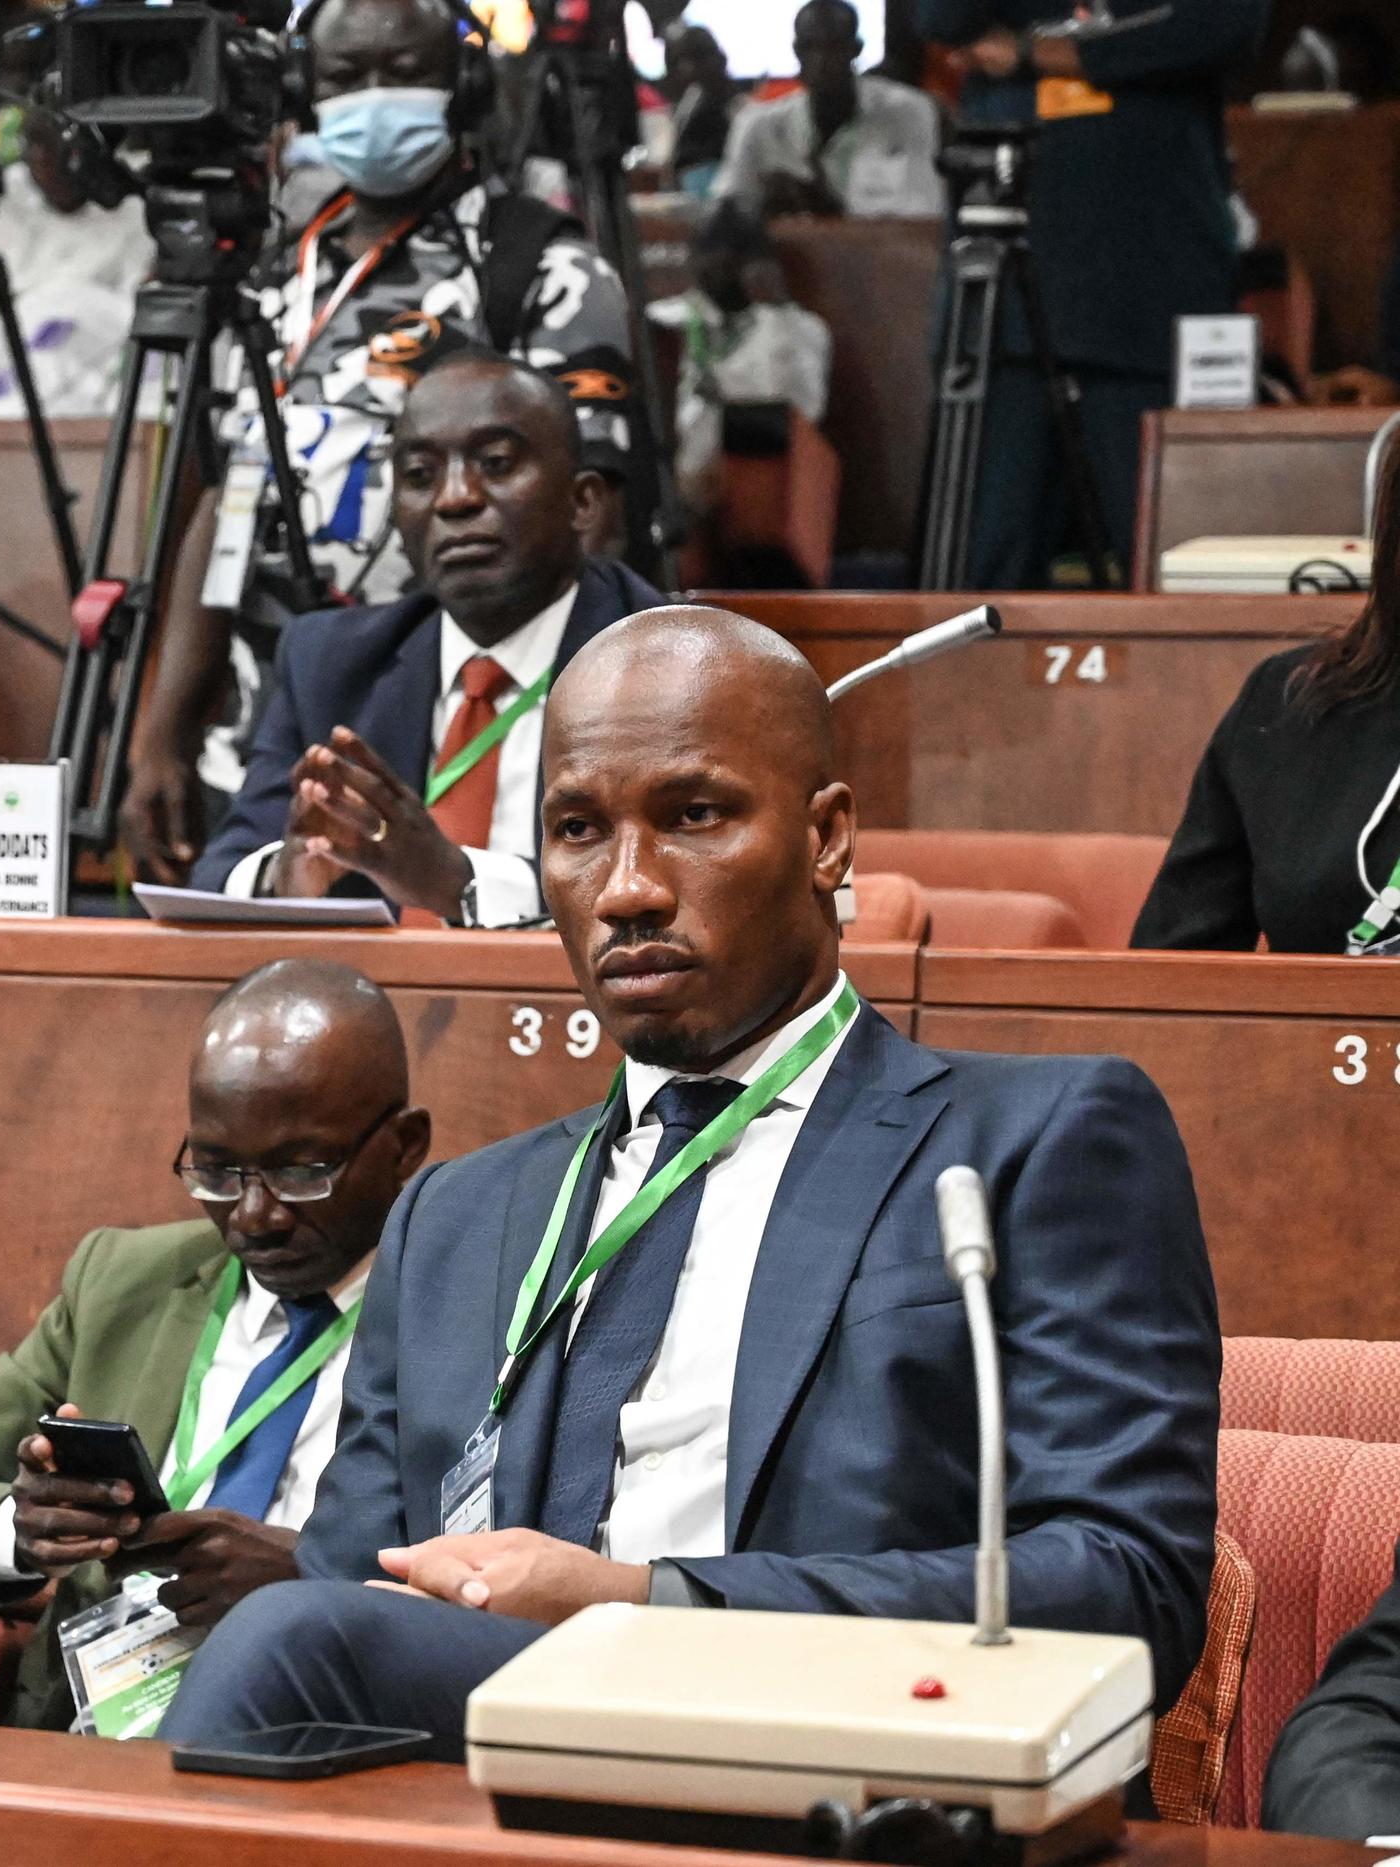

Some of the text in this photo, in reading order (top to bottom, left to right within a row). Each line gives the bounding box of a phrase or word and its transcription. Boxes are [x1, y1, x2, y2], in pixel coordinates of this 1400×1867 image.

[1045, 646, 1107, 684] 74
[509, 1007, 600, 1059] 39
[1332, 1034, 1400, 1086] 3
